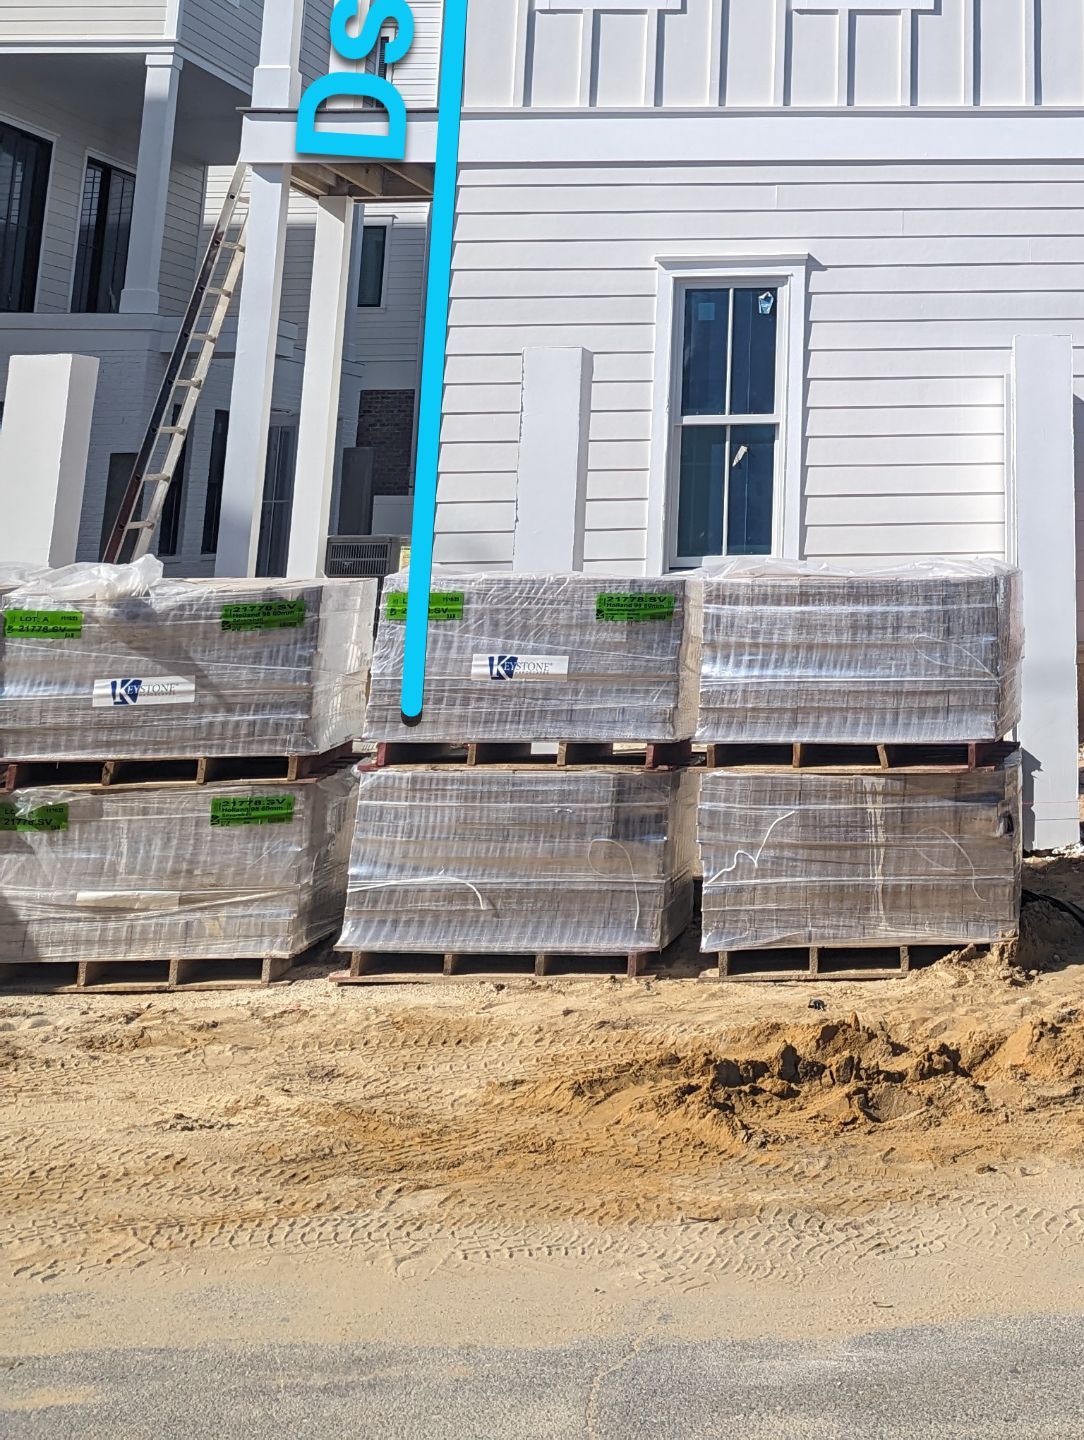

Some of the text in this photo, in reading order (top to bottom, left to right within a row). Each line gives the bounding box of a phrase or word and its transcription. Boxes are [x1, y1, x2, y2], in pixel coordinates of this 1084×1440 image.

[232, 603, 297, 613] 21778.SV
[18, 625, 66, 633] 21778.SV
[488, 655, 550, 680] KEYSTONE
[111, 678, 176, 705] KEYSTONE
